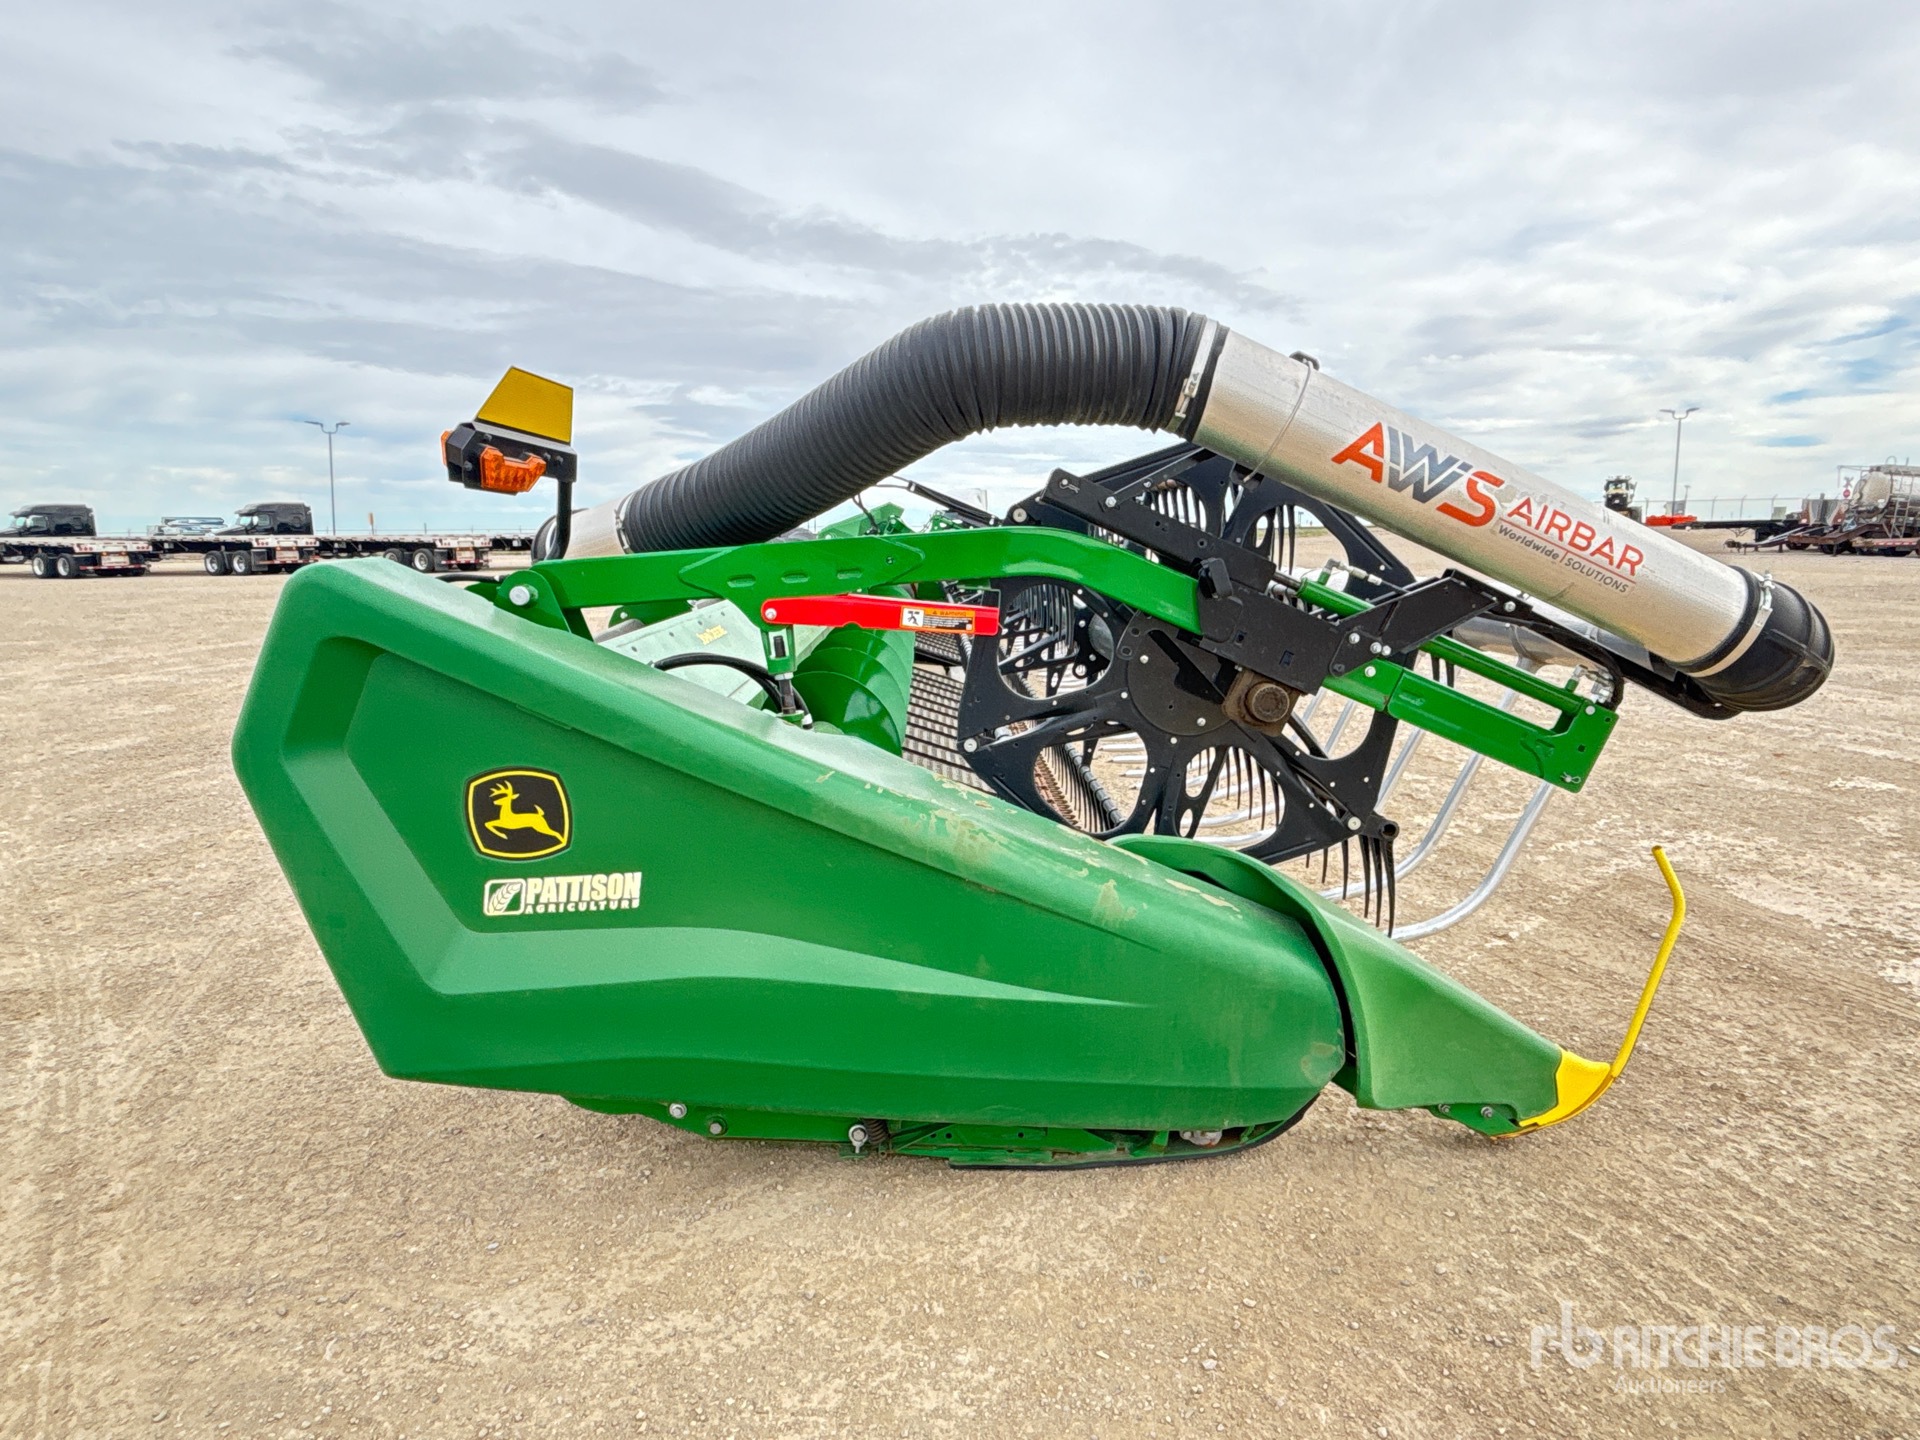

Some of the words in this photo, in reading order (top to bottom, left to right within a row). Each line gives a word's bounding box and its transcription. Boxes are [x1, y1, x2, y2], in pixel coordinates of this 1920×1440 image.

[1331, 421, 1505, 527] AWS
[1507, 496, 1645, 577] AIRBAR
[1498, 524, 1560, 561] Worldwide
[1564, 557, 1629, 593] SOLUTIONS
[525, 897, 640, 914] AGRICULTURE
[526, 871, 642, 904] PATTISON
